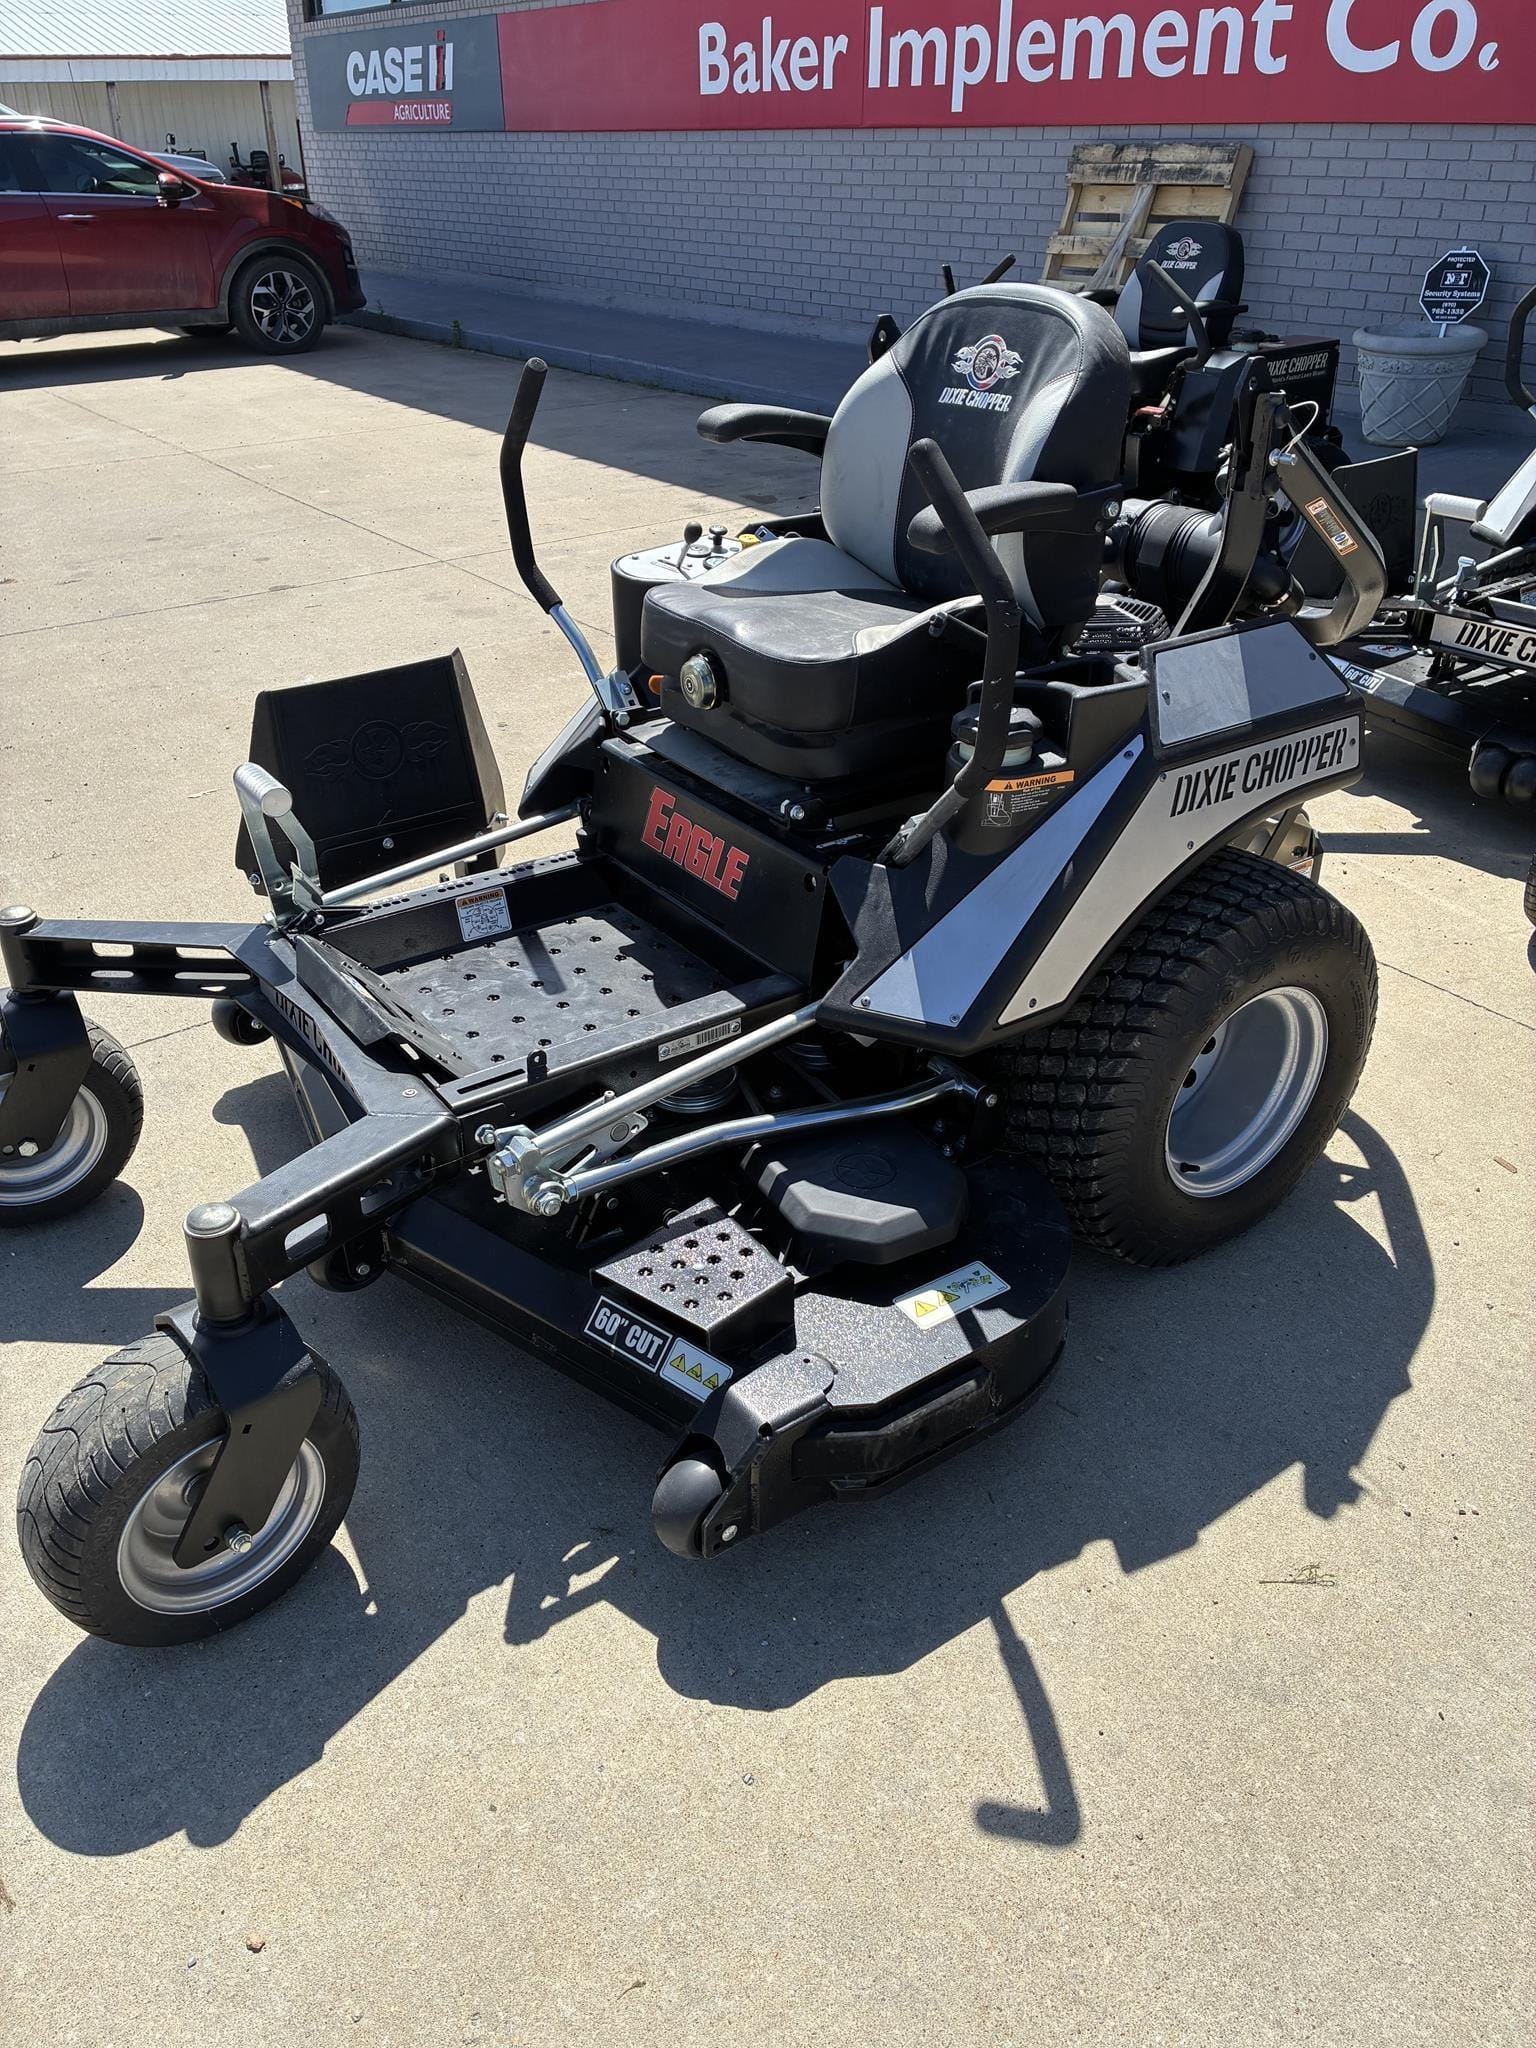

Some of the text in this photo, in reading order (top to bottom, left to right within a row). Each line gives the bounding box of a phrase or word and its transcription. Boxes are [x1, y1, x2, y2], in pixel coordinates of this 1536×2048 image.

[699, 0, 1499, 113] Baker Implement Co.
[346, 45, 423, 96] CASE
[394, 103, 451, 121] AGRICULTURE
[1424, 289, 1481, 298] Security Systems
[1288, 352, 1329, 373] CHOPPER
[938, 387, 1012, 412] DIXIE CHOPPER
[1455, 621, 1519, 658] DIXIE
[1359, 674, 1380, 689] CUT
[1016, 775, 1057, 789] WARNING
[1170, 727, 1348, 818] DIXIE CHOPPER
[641, 786, 750, 901] EAGLE
[467, 891, 500, 905] WARNING
[594, 1307, 664, 1360] 60" CUT
